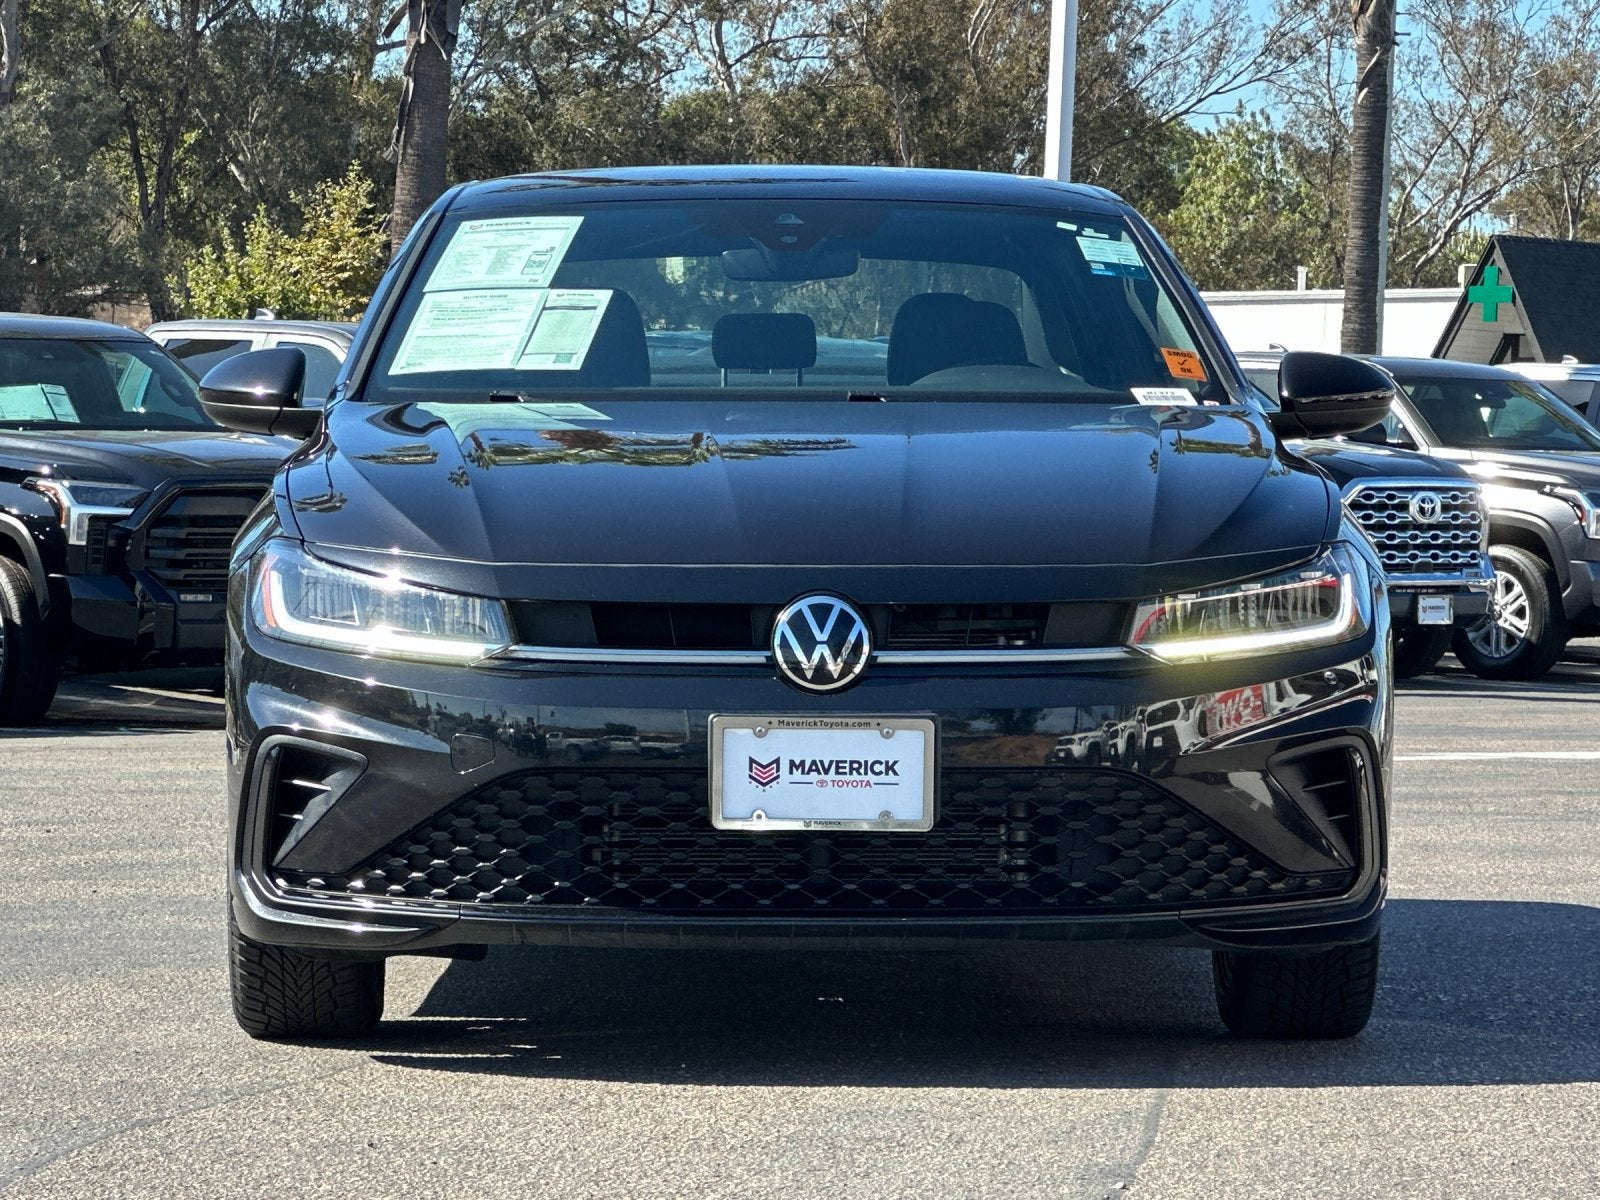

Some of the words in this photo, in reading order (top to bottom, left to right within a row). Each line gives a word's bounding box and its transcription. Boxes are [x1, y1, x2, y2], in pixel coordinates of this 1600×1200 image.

[1166, 350, 1193, 359] SMOG
[777, 719, 871, 729] MaverickToyota.com
[788, 759, 900, 776] MAVERICK
[831, 779, 872, 789] TOYOTA
